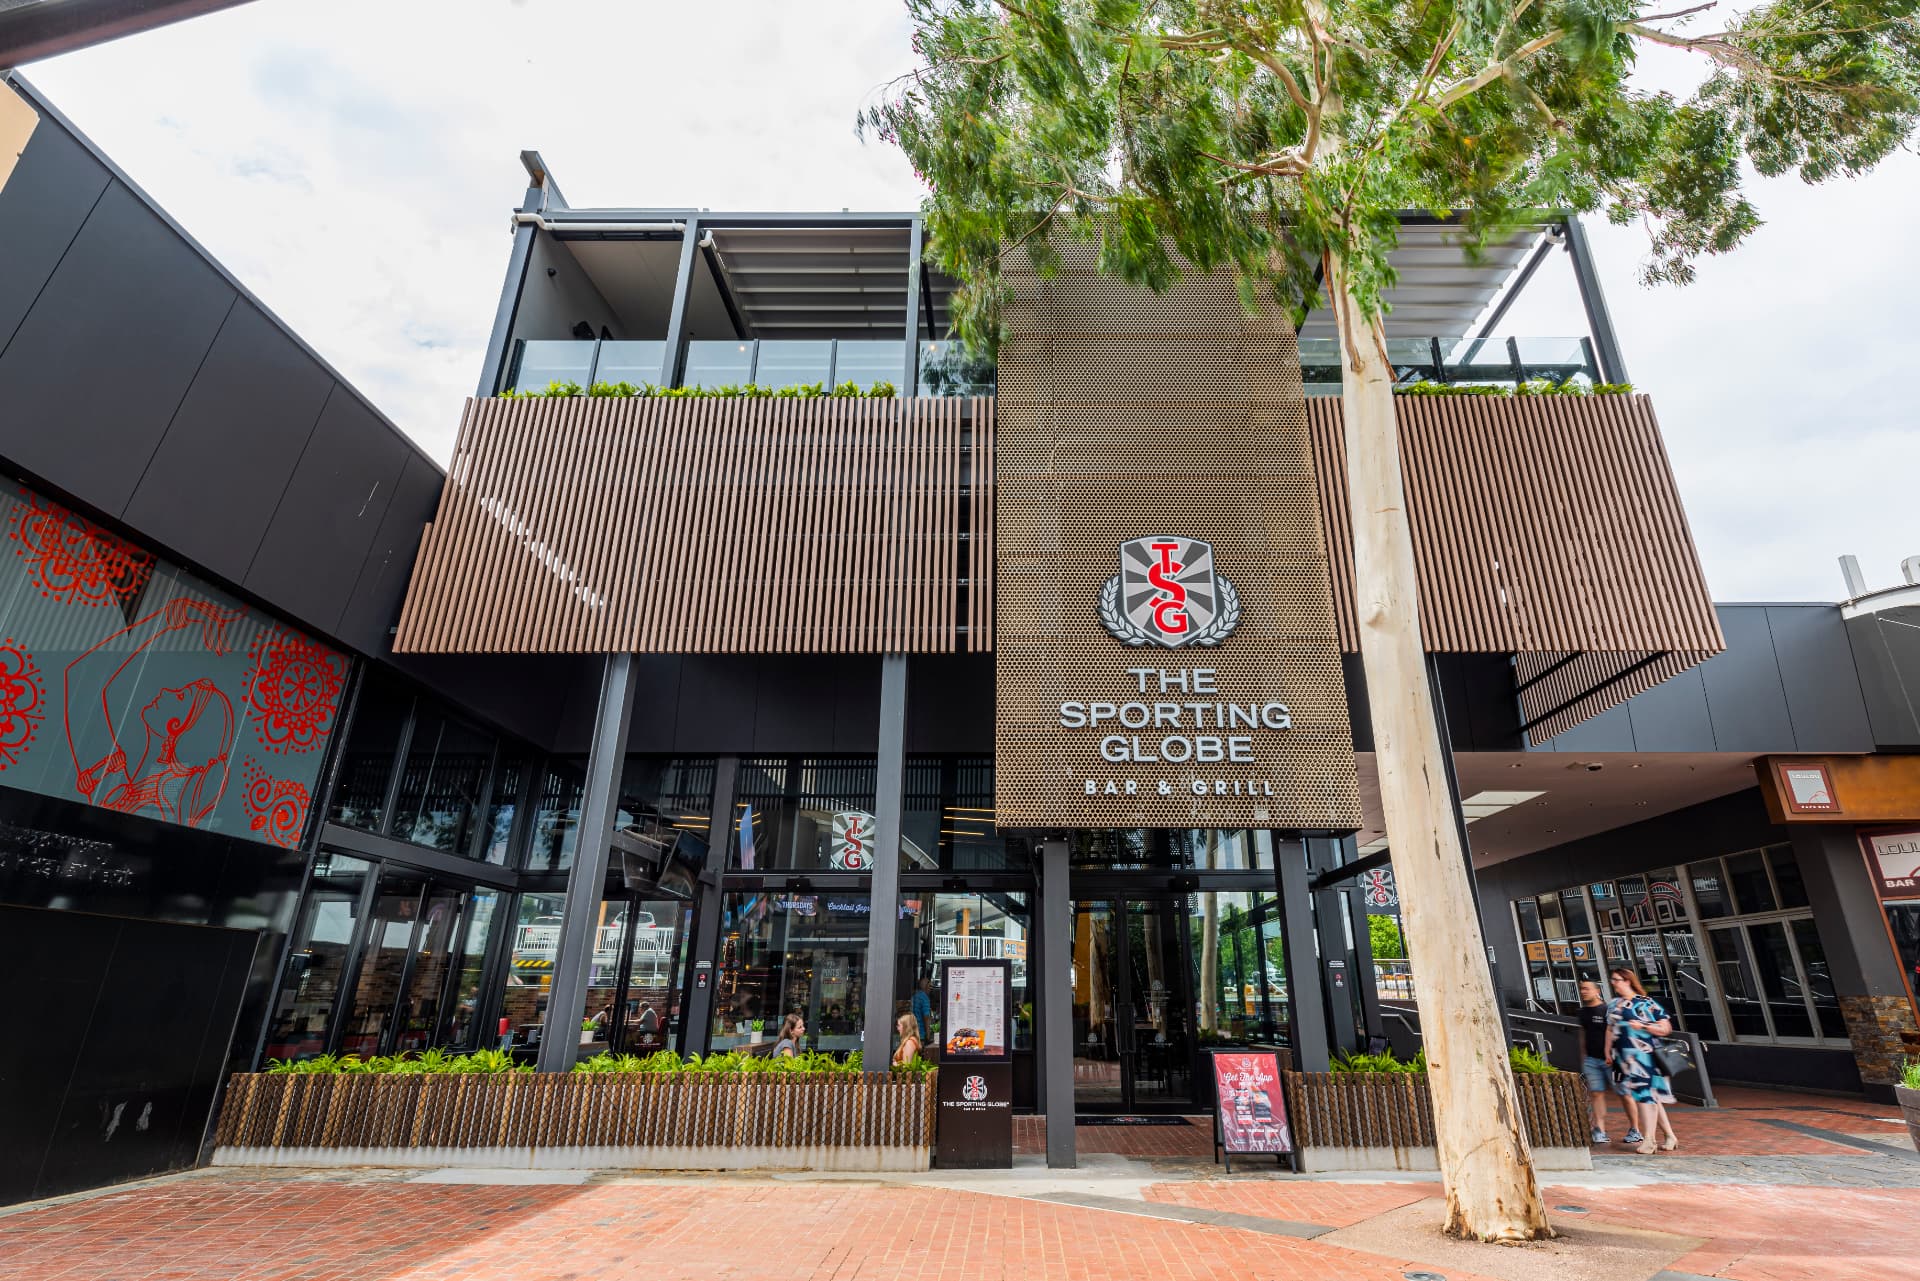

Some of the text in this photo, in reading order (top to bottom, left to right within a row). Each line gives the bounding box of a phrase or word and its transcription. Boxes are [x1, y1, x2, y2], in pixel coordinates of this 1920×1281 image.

[1147, 542, 1189, 634] TSG
[1127, 668, 1218, 694] THE
[1059, 702, 1292, 729] SPORTING
[1100, 735, 1255, 763] GLOBE
[1085, 780, 1274, 796] BAR & GRILL
[844, 815, 864, 869] TSG
[1372, 870, 1387, 904] TSG
[1885, 879, 1915, 888] BAR
[782, 901, 813, 910] THURSDAYS
